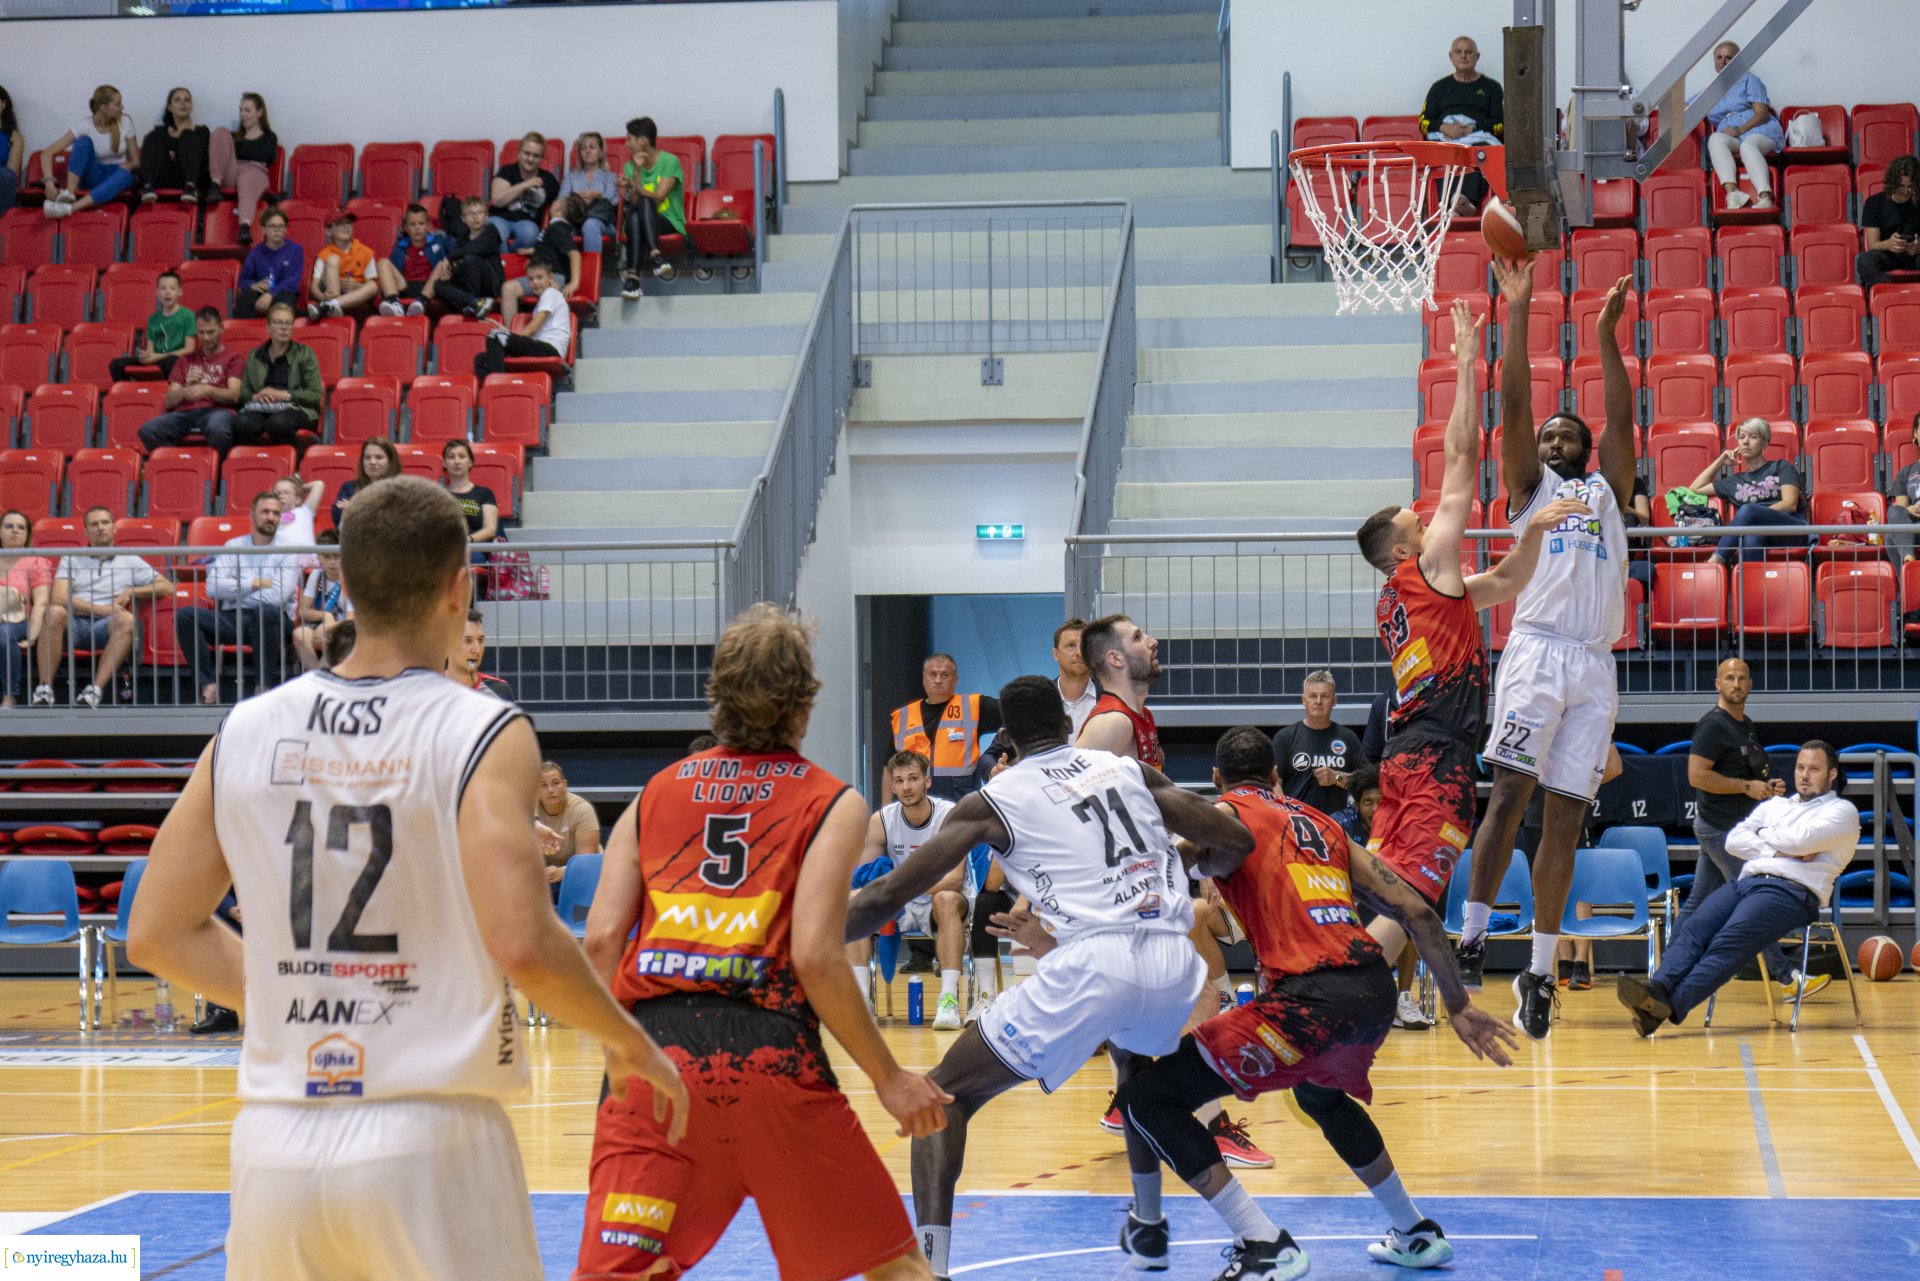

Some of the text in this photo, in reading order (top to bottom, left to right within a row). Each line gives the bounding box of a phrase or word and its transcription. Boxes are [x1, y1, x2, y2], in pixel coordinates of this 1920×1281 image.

[307, 693, 388, 735] KISS
[947, 704, 961, 719] 03
[1499, 721, 1531, 752] 22
[283, 752, 412, 776] EISSMANN
[1040, 755, 1092, 781] KONE
[1311, 755, 1346, 768] JAKO
[692, 782, 774, 802] LIONS
[1632, 800, 1648, 817] 12
[1071, 787, 1149, 869] 21
[1289, 814, 1329, 861] 4
[699, 813, 751, 889] 5
[285, 800, 399, 953] 12
[659, 904, 759, 935] MVM
[285, 998, 397, 1025] ALANEX
[614, 1201, 664, 1220] MVM
